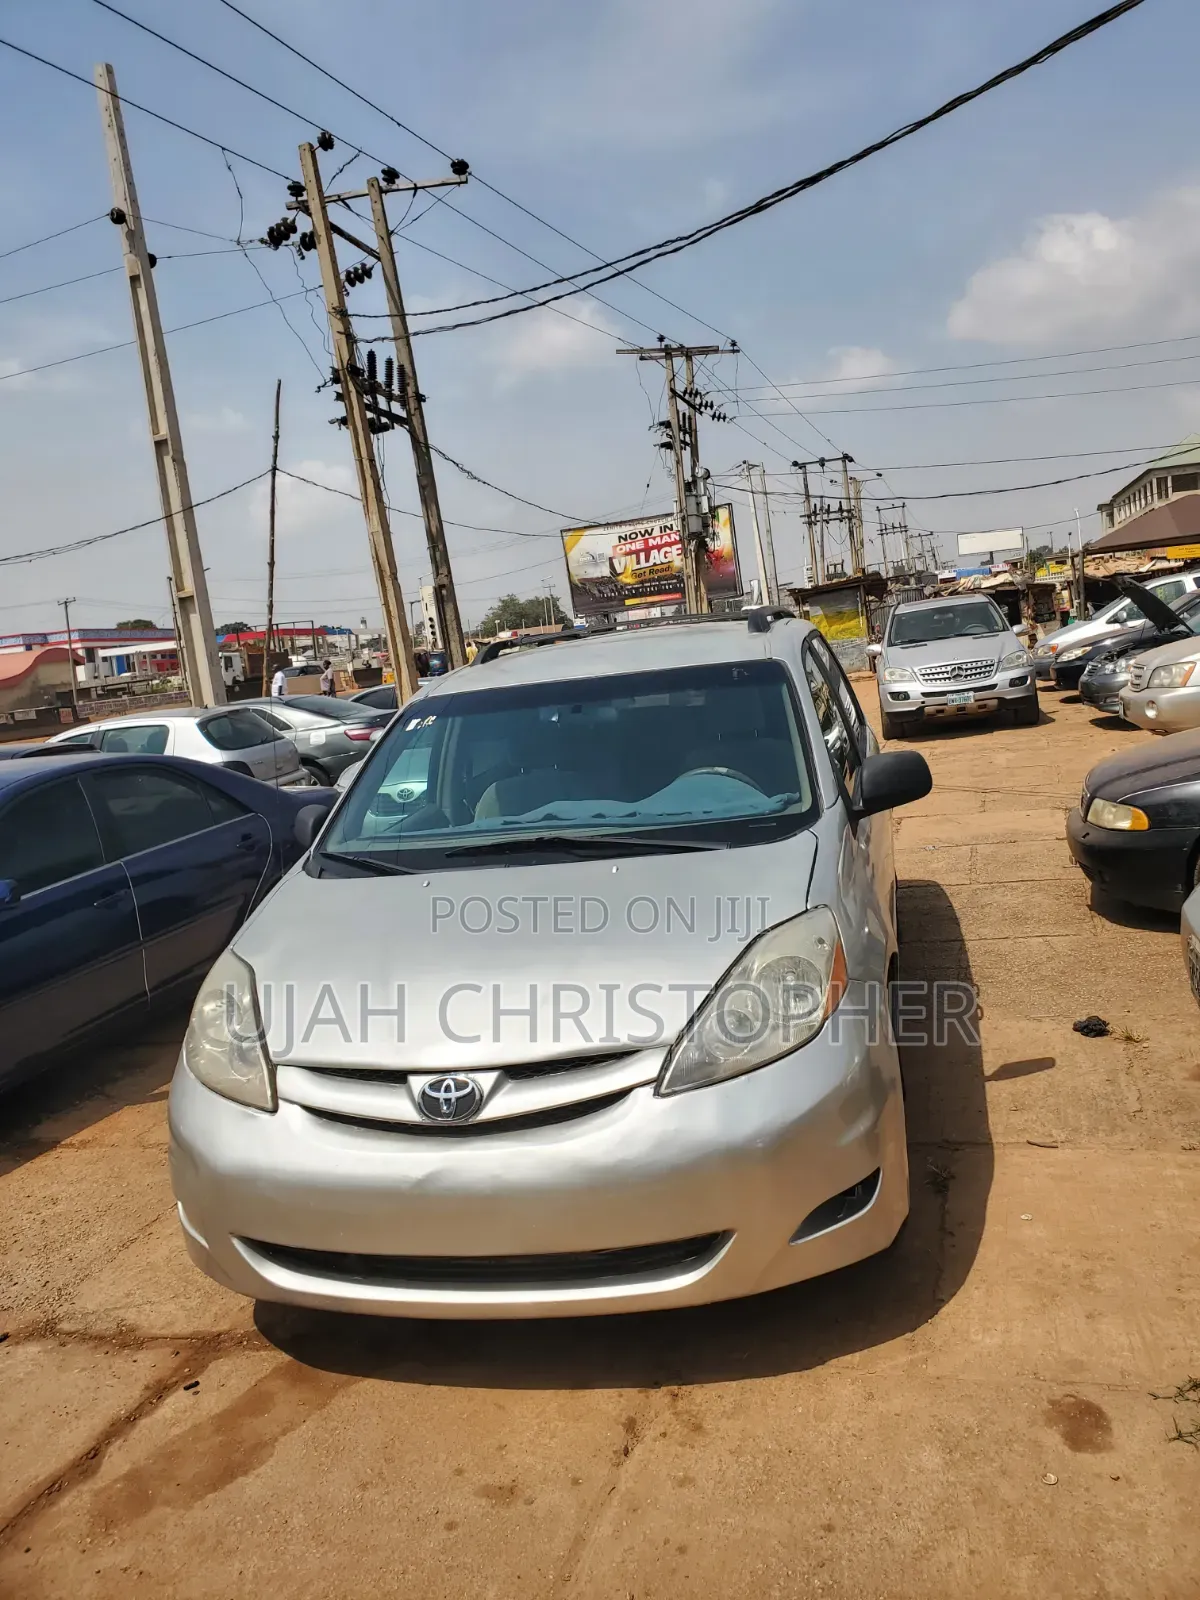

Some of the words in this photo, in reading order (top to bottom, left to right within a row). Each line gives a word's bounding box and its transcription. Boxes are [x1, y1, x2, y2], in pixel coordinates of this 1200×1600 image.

[616, 540, 645, 554] ONE
[648, 532, 680, 547] MAN
[617, 527, 655, 543] NOW
[659, 523, 674, 534] IN
[612, 544, 682, 574] VILLAGE
[631, 571, 647, 580] Get
[648, 565, 674, 577] Ready
